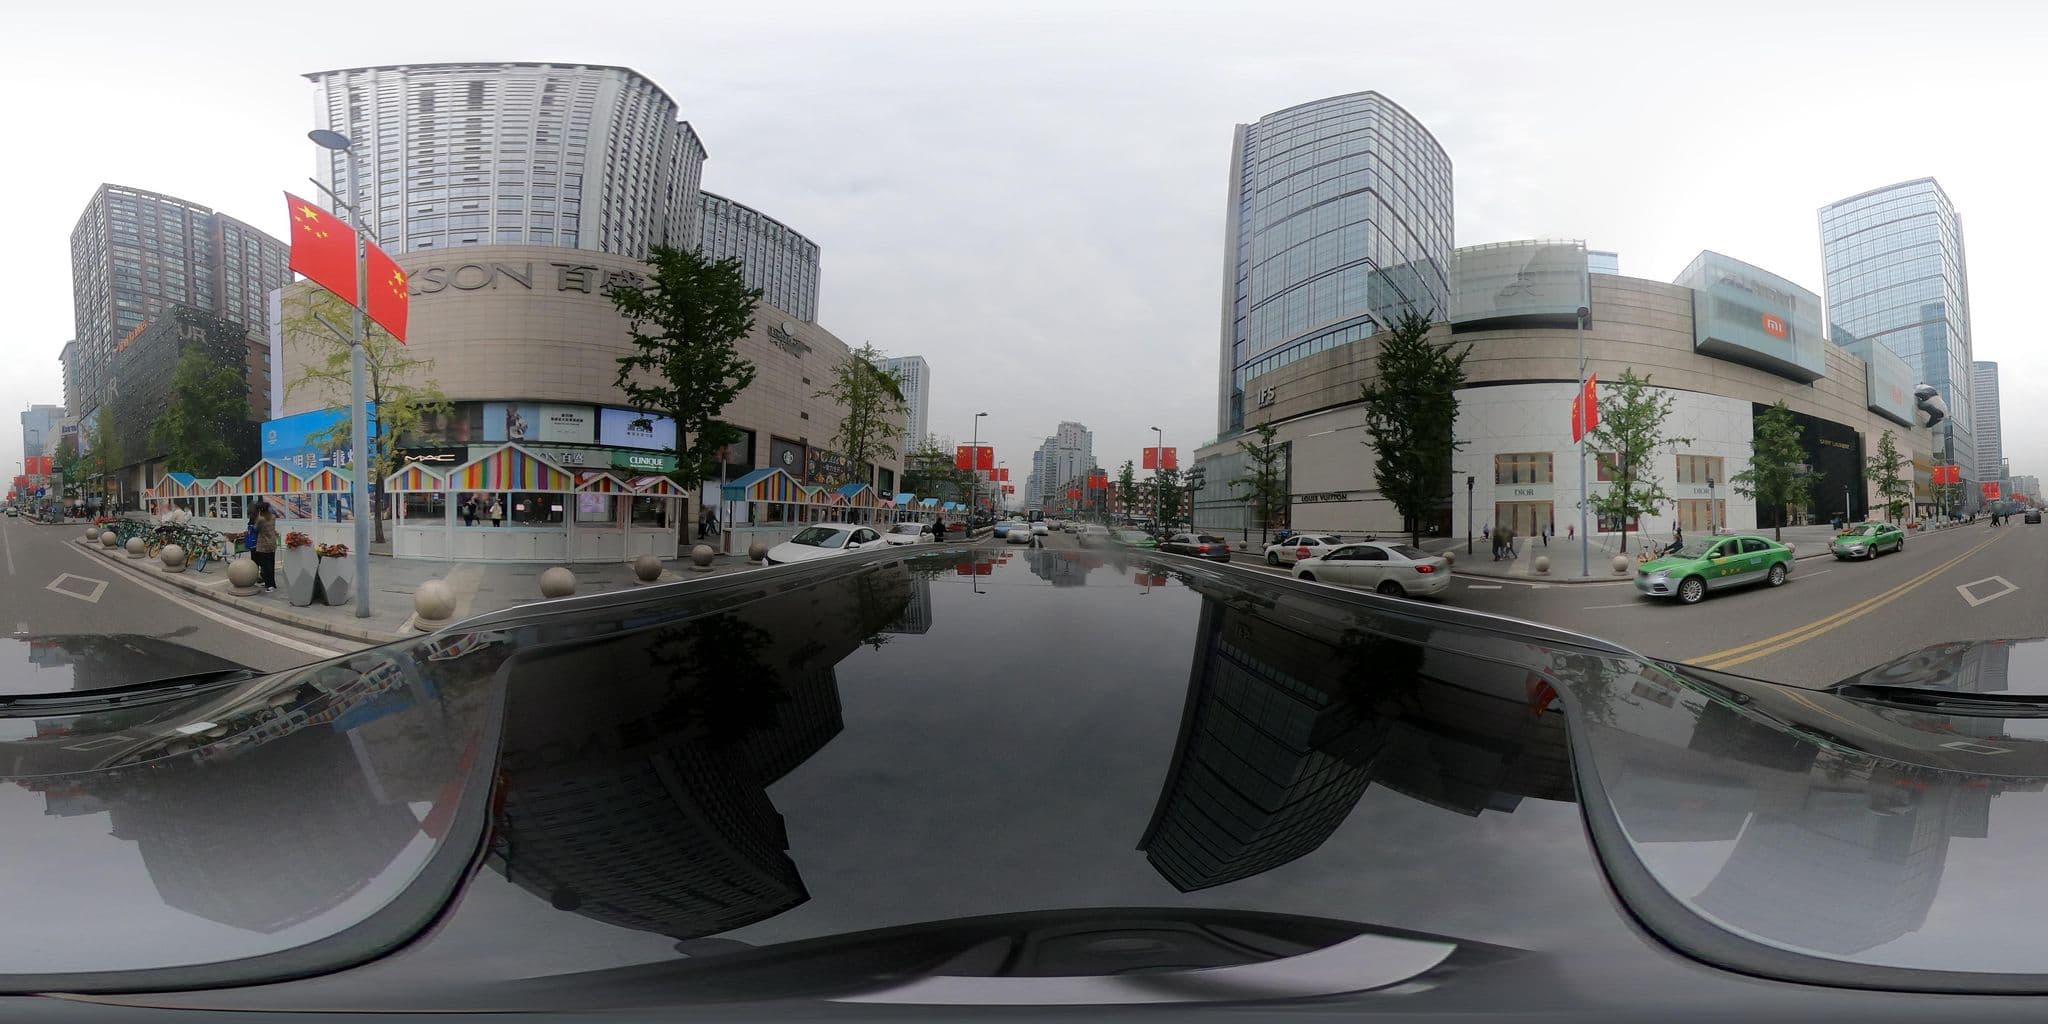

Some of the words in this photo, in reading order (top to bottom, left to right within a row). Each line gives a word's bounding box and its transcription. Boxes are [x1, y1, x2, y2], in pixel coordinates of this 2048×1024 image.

[407, 262, 533, 296] KSON
[1257, 385, 1276, 405] IFS
[629, 456, 664, 466] CLINIQUE
[1514, 488, 1535, 496] DIOR
